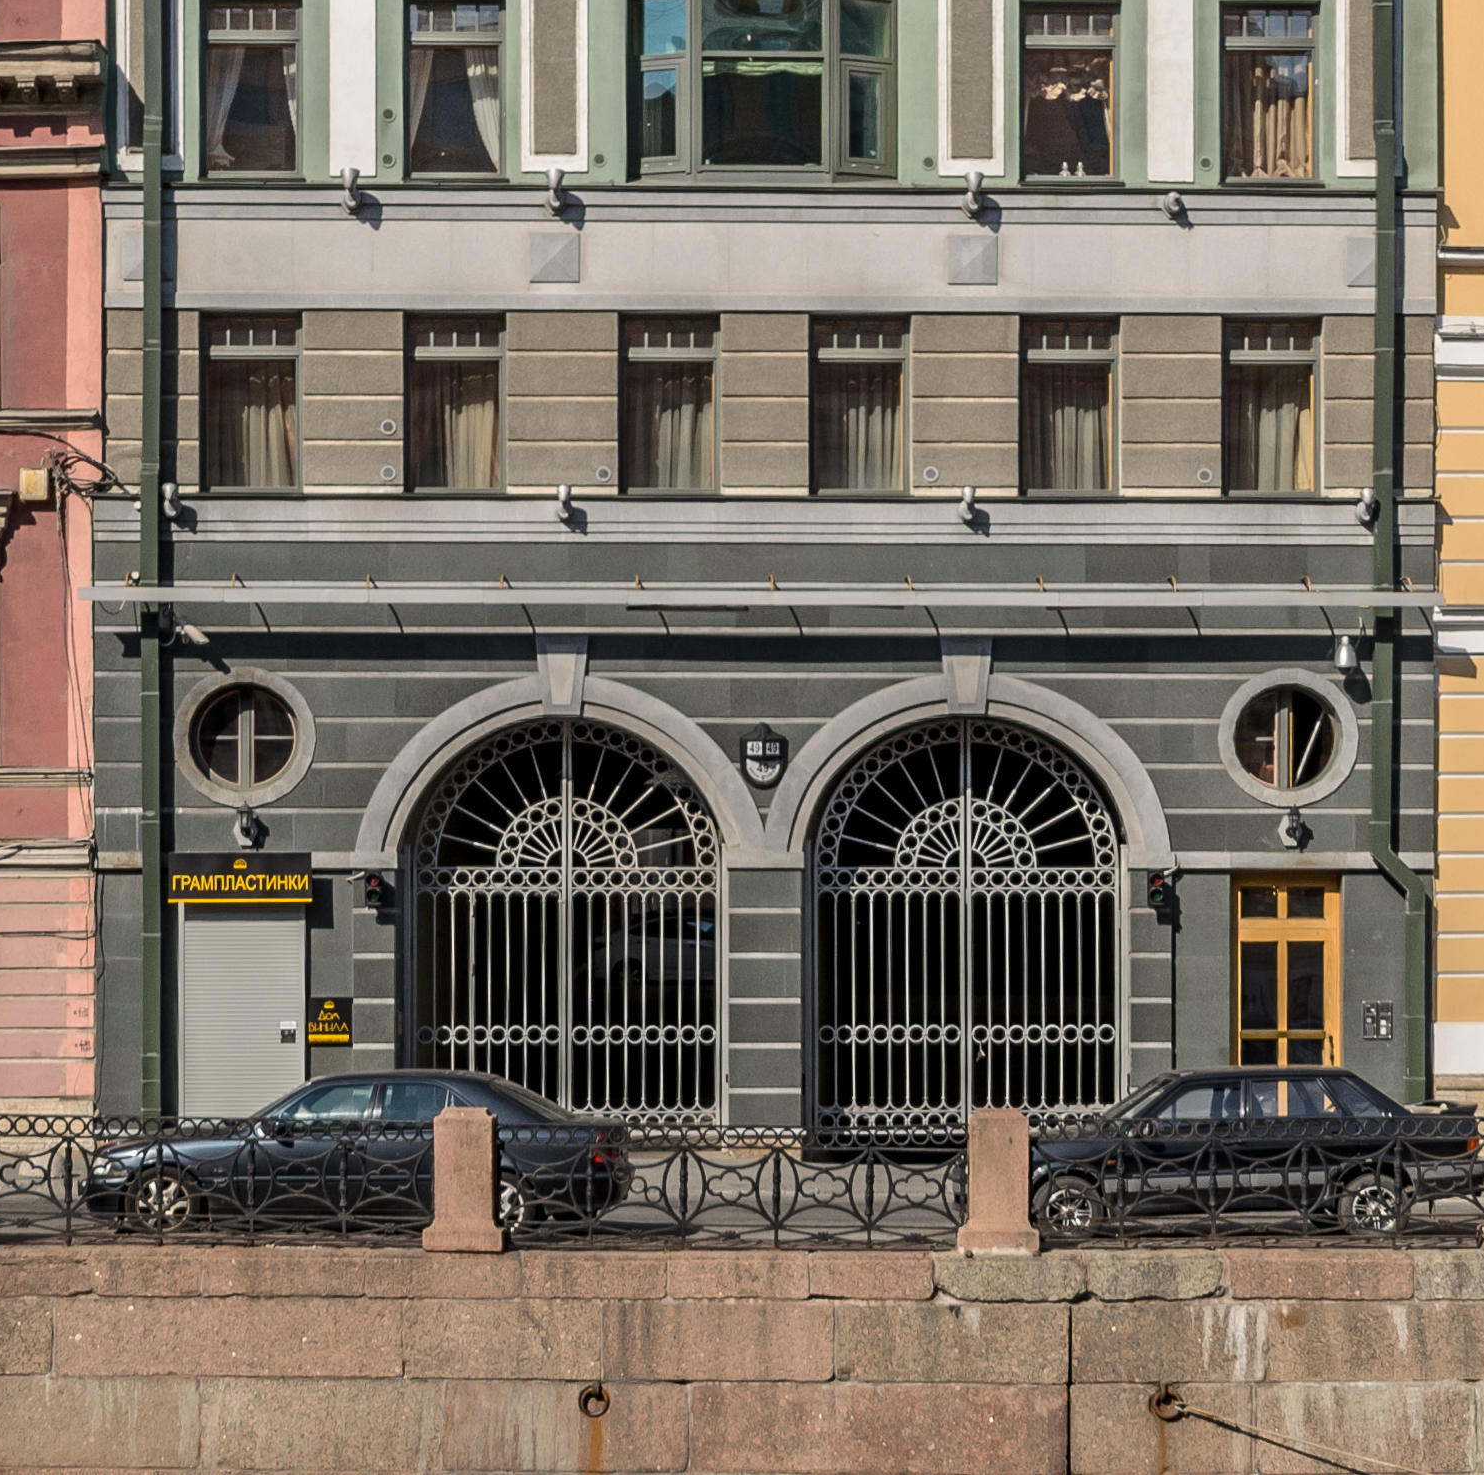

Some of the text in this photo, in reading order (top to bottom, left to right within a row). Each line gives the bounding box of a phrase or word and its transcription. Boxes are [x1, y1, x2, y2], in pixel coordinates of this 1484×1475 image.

[749, 742, 778, 753] 49 49
[172, 874, 309, 892] ГРАМПЛАСТИНКИ
